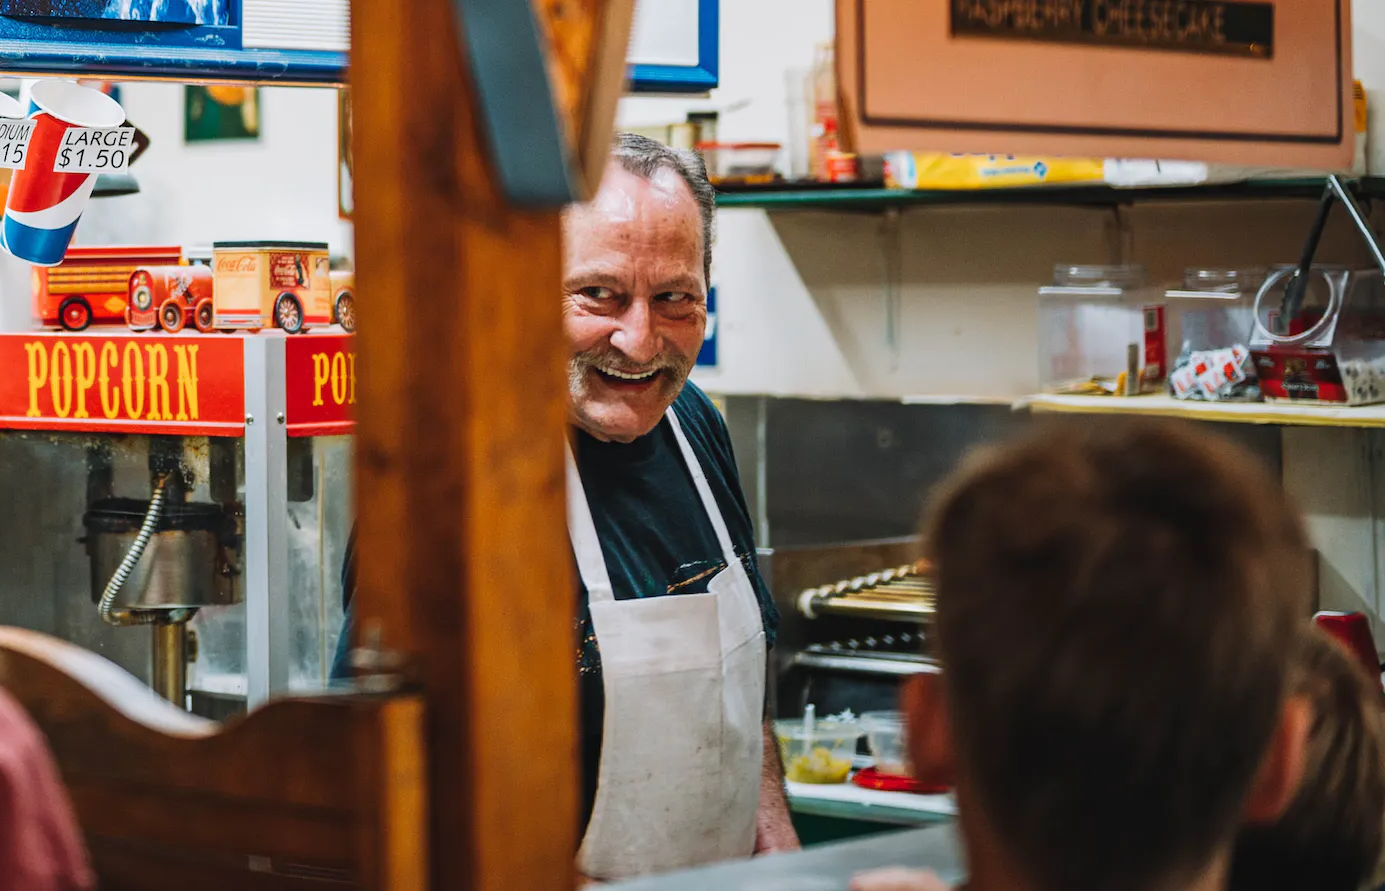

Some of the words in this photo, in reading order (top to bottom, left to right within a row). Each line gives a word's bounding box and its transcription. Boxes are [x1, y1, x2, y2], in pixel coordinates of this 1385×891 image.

[65, 130, 130, 148] LARGE
[58, 148, 126, 170] $1.50
[24, 340, 200, 422] POPCORN
